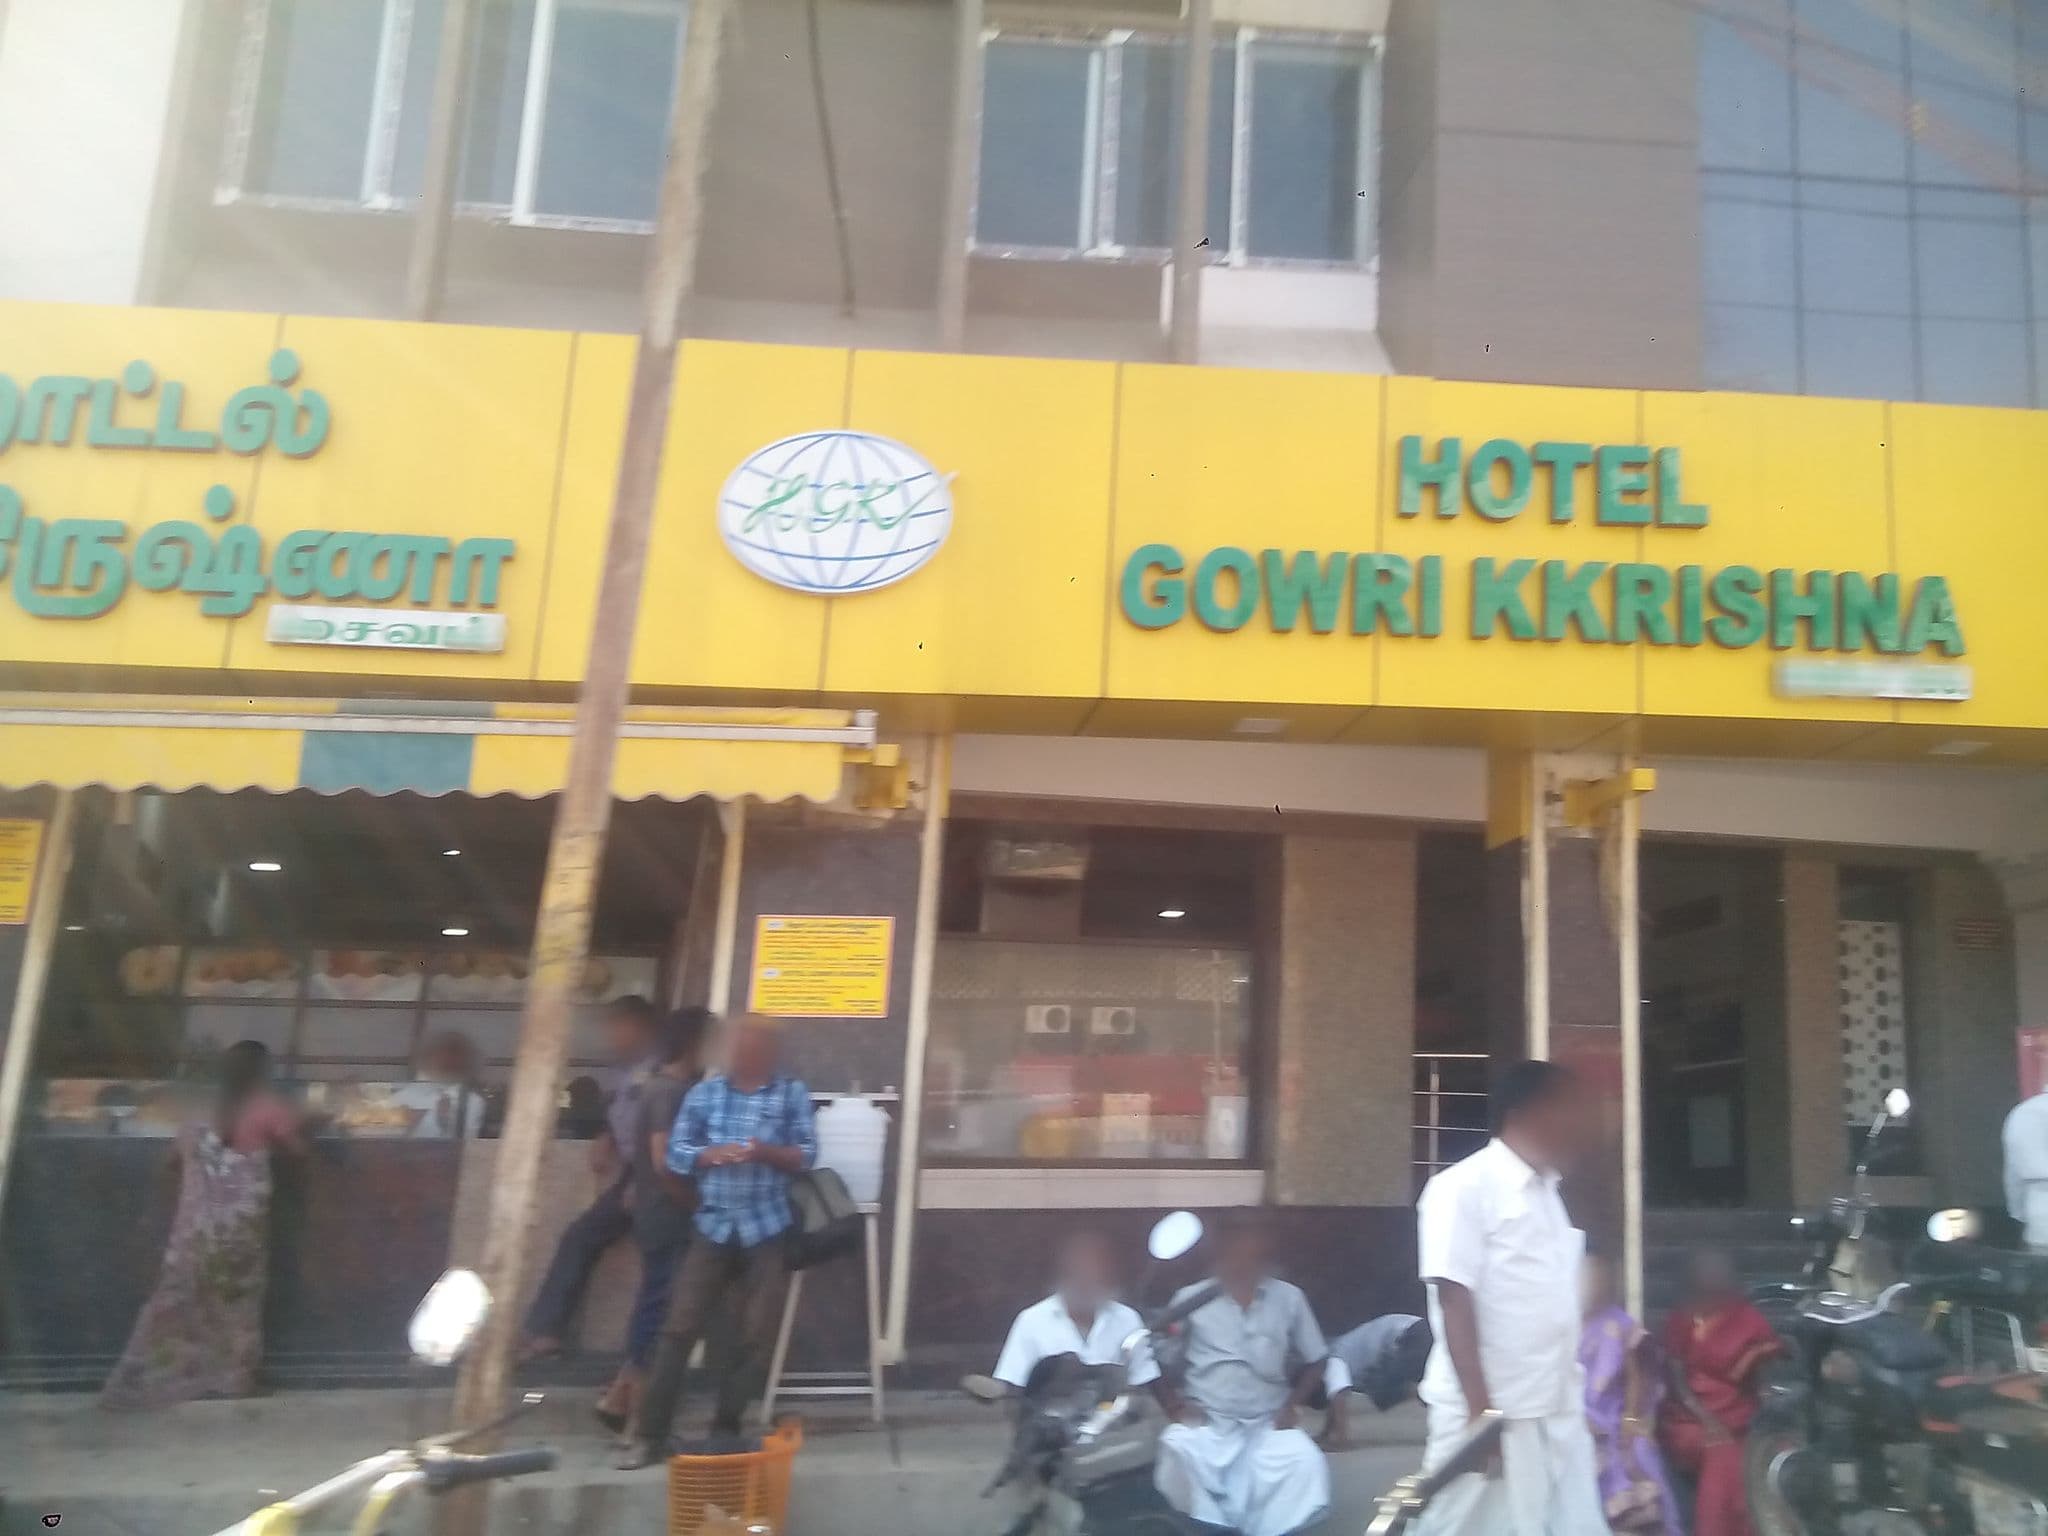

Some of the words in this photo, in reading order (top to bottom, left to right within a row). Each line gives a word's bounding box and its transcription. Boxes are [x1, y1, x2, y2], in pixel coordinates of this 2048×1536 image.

[1399, 435, 1708, 528] HOTEL
[0, 484, 515, 618] ருஷ்ணா
[1120, 544, 1443, 638] GOWRI
[1473, 556, 1966, 656] KKRISHNA
